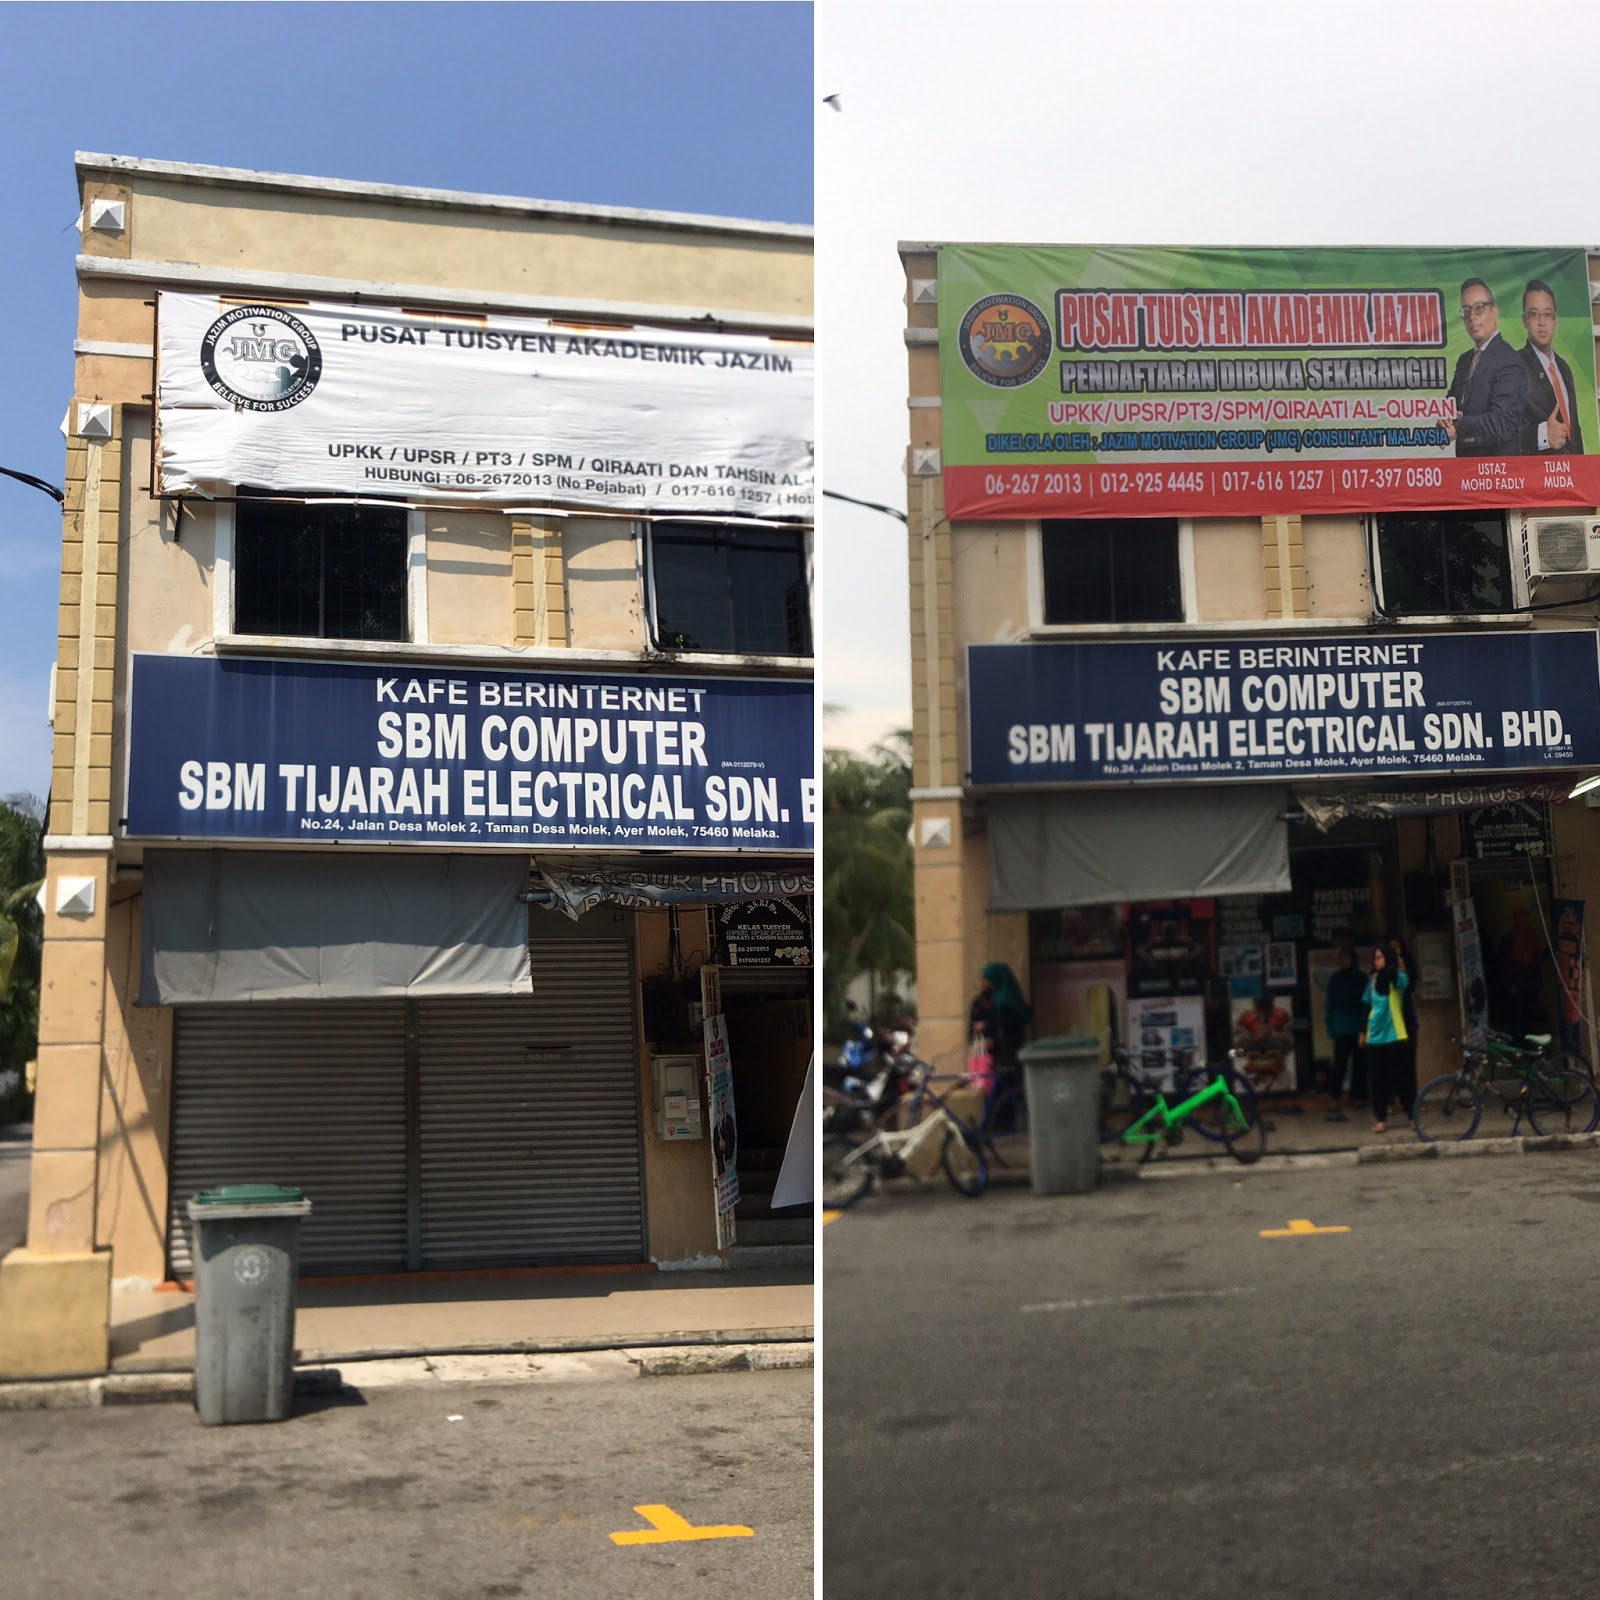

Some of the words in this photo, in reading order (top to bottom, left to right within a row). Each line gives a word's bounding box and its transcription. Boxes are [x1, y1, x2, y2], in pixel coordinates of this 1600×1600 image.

[205, 320, 228, 346] JAZIM
[227, 307, 291, 323] MOTIVATION
[291, 320, 318, 351] GROUP
[963, 308, 979, 331] JAZIM
[978, 296, 1027, 310] MOTIVATION
[1027, 305, 1048, 331] GROUP
[1058, 291, 1139, 347] PUSAT
[1141, 291, 1243, 347] TUISYEN
[1245, 290, 1370, 346] AKADEMIK
[1370, 290, 1443, 346] JAZIM
[231, 337, 301, 363] JMG
[341, 323, 430, 346] PUSAT
[439, 327, 556, 354] TUISYEN
[566, 336, 705, 367] AKADEMIK
[715, 351, 793, 373] JAZIM
[970, 362, 998, 385] BELIEVE
[1000, 378, 1017, 387] FOR
[1019, 358, 1046, 384] SUCCESS
[1061, 360, 1217, 393] PENDAFTARAN
[1218, 358, 1304, 392] DIBUKA
[1307, 357, 1447, 390] SEKARANG!!!
[211, 382, 251, 410] BELIEVE
[252, 403, 275, 412] FOR
[276, 381, 315, 411] SUCCESS
[1352, 398, 1455, 419] AL-QURAN
[986, 433, 1051, 452] DIKELOLA
[1053, 433, 1090, 451] OLEH
[1100, 432, 1138, 451] JAZIM
[1140, 431, 1217, 450] MOTIVATION
[1217, 431, 1264, 449] GROUP
[1265, 429, 1302, 452] (JMG)
[1303, 429, 1386, 448] CONSULTANT
[1387, 427, 1449, 446] MALAYSIA
[327, 443, 383, 460] UPKK
[403, 448, 455, 465] UPSR
[476, 452, 512, 467] PT3
[531, 452, 573, 469] SPM
[591, 458, 663, 477] QIRAATI
[669, 464, 708, 478] DAN
[715, 465, 776, 485] TAHSIN
[781, 473, 814, 487] AL-
[1478, 462, 1507, 476] USTAZ
[1544, 461, 1571, 474] TUAN
[364, 466, 441, 484] HUBUNGI
[456, 473, 552, 486] 06-2672013
[556, 474, 581, 490] (No
[585, 477, 646, 498] Pejabat)
[671, 485, 736, 497] 017-616
[739, 488, 772, 504] 1257
[787, 494, 814, 504] Hot
[984, 473, 1040, 495] 06-267
[1045, 473, 1083, 493] 2013
[1100, 472, 1163, 493] 012-925
[1167, 471, 1204, 492] 4445
[1222, 470, 1284, 492] 017-616
[1288, 470, 1324, 490] 1257
[1342, 468, 1402, 490] 017-397
[1406, 467, 1442, 487] 0580
[1461, 478, 1494, 492] MOHD
[1496, 477, 1525, 490] FADLY
[1544, 475, 1574, 488] MUDA
[1157, 650, 1232, 671] KAFE
[1239, 644, 1424, 670] BERINTERNET
[376, 677, 469, 705] KAFE
[479, 681, 707, 713] BERINTERNET
[1159, 676, 1232, 716] SBM
[1241, 671, 1427, 714] COMPUTER
[377, 711, 467, 760] SBM
[481, 714, 709, 767] COMPUTER
[1008, 724, 1076, 765] SBM
[1084, 720, 1219, 762] TIJARAH
[1228, 713, 1415, 757] ELECTRICAL
[1423, 711, 1493, 751] SDN.
[1501, 709, 1572, 748] BHD.
[1140, 763, 1169, 774] Jalan
[1171, 762, 1198, 772] Desa
[1201, 760, 1233, 771] Molek
[1247, 759, 1283, 770] Taman
[1285, 758, 1311, 768] Desa
[1314, 757, 1349, 768] Molek,
[1350, 756, 1374, 767] Ayer
[1377, 754, 1412, 765] Molek,
[1413, 753, 1443, 763] 75460
[1446, 752, 1485, 762] Melaka.
[178, 760, 266, 811] SBM
[278, 764, 449, 815] TIJARAH
[463, 769, 695, 821] ELECTRICAL
[704, 775, 790, 823] SDN.
[300, 817, 344, 832] No.24,
[348, 818, 384, 831] Jalan
[389, 819, 423, 832] Desa
[426, 820, 466, 832] Molek
[469, 821, 482, 834] 2,
[485, 822, 529, 834] Taman
[533, 822, 565, 834] Desa
[569, 823, 611, 837] Molek,
[614, 824, 645, 838] Ayer
[647, 825, 689, 838] Molek,
[692, 826, 729, 838] 75460
[732, 826, 780, 839] Melaka.
